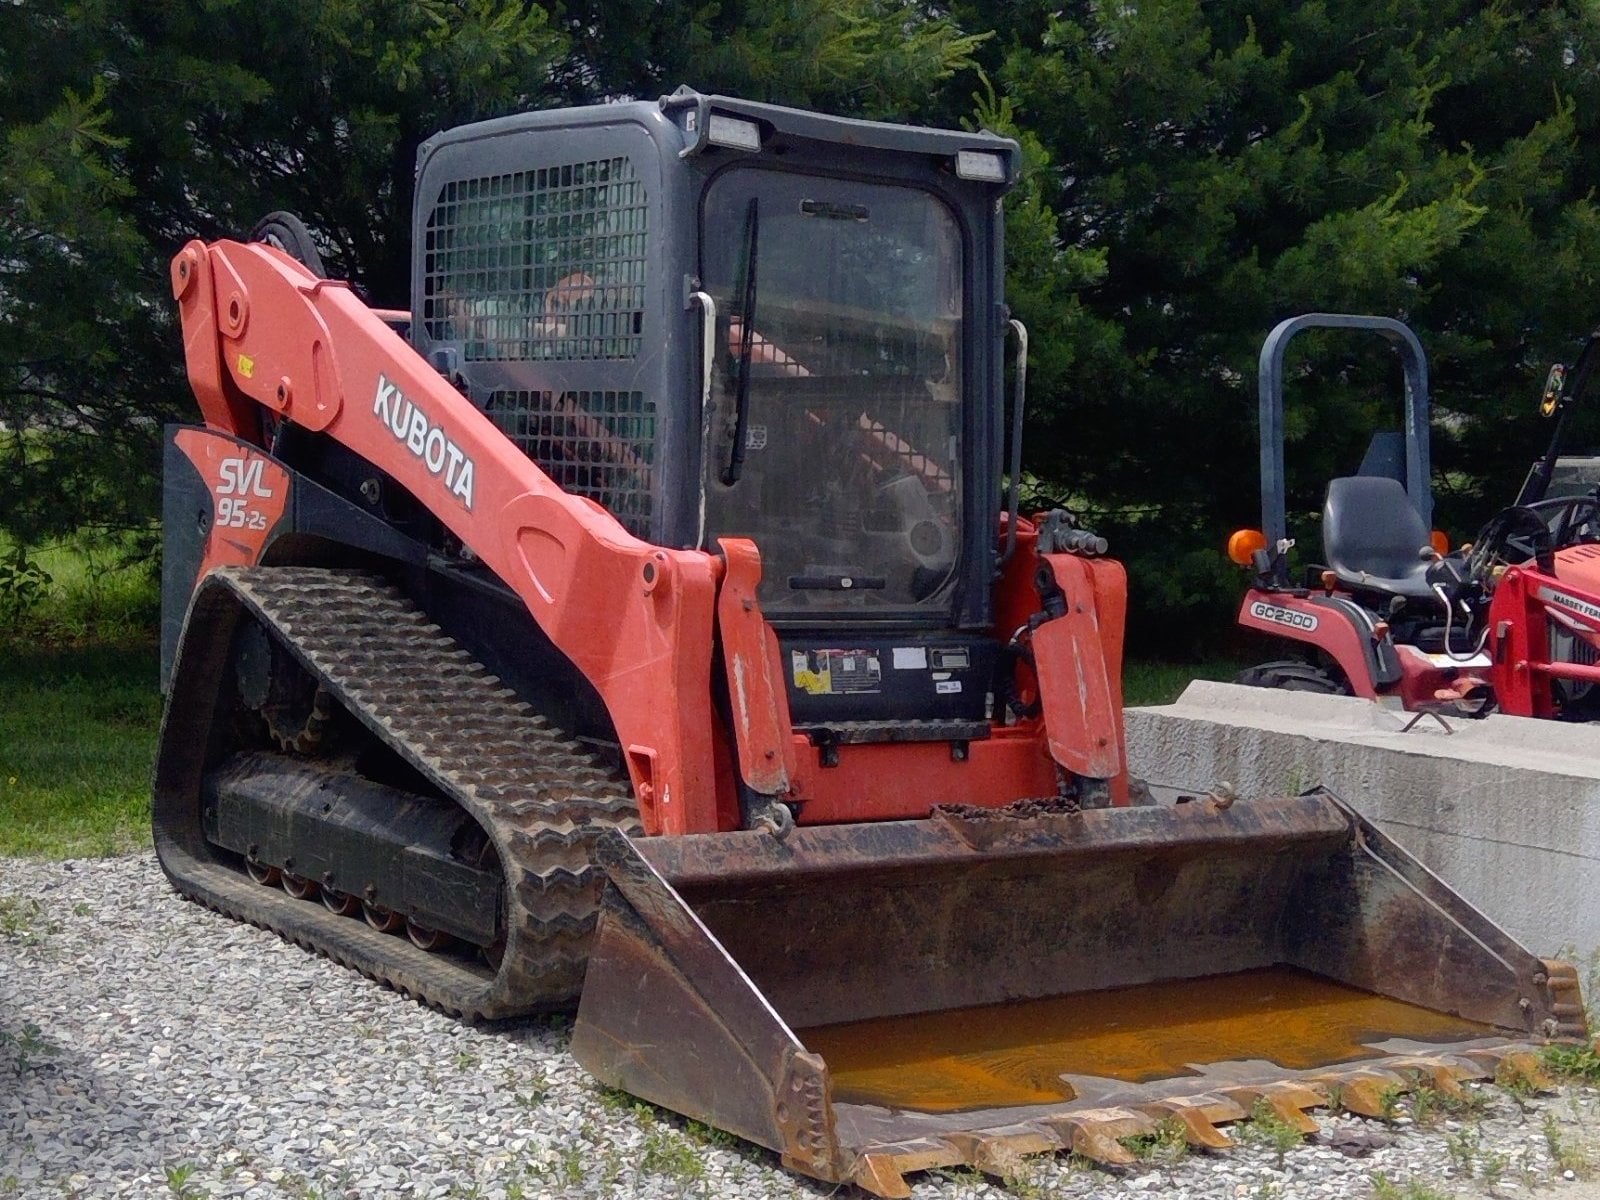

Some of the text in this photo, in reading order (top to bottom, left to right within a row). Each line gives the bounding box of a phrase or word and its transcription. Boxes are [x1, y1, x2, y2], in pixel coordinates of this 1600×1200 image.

[373, 374, 474, 509] KUBOTA
[215, 458, 272, 498] SVL
[1255, 604, 1313, 628] GC2300
[1553, 594, 1583, 611] MASSEY
